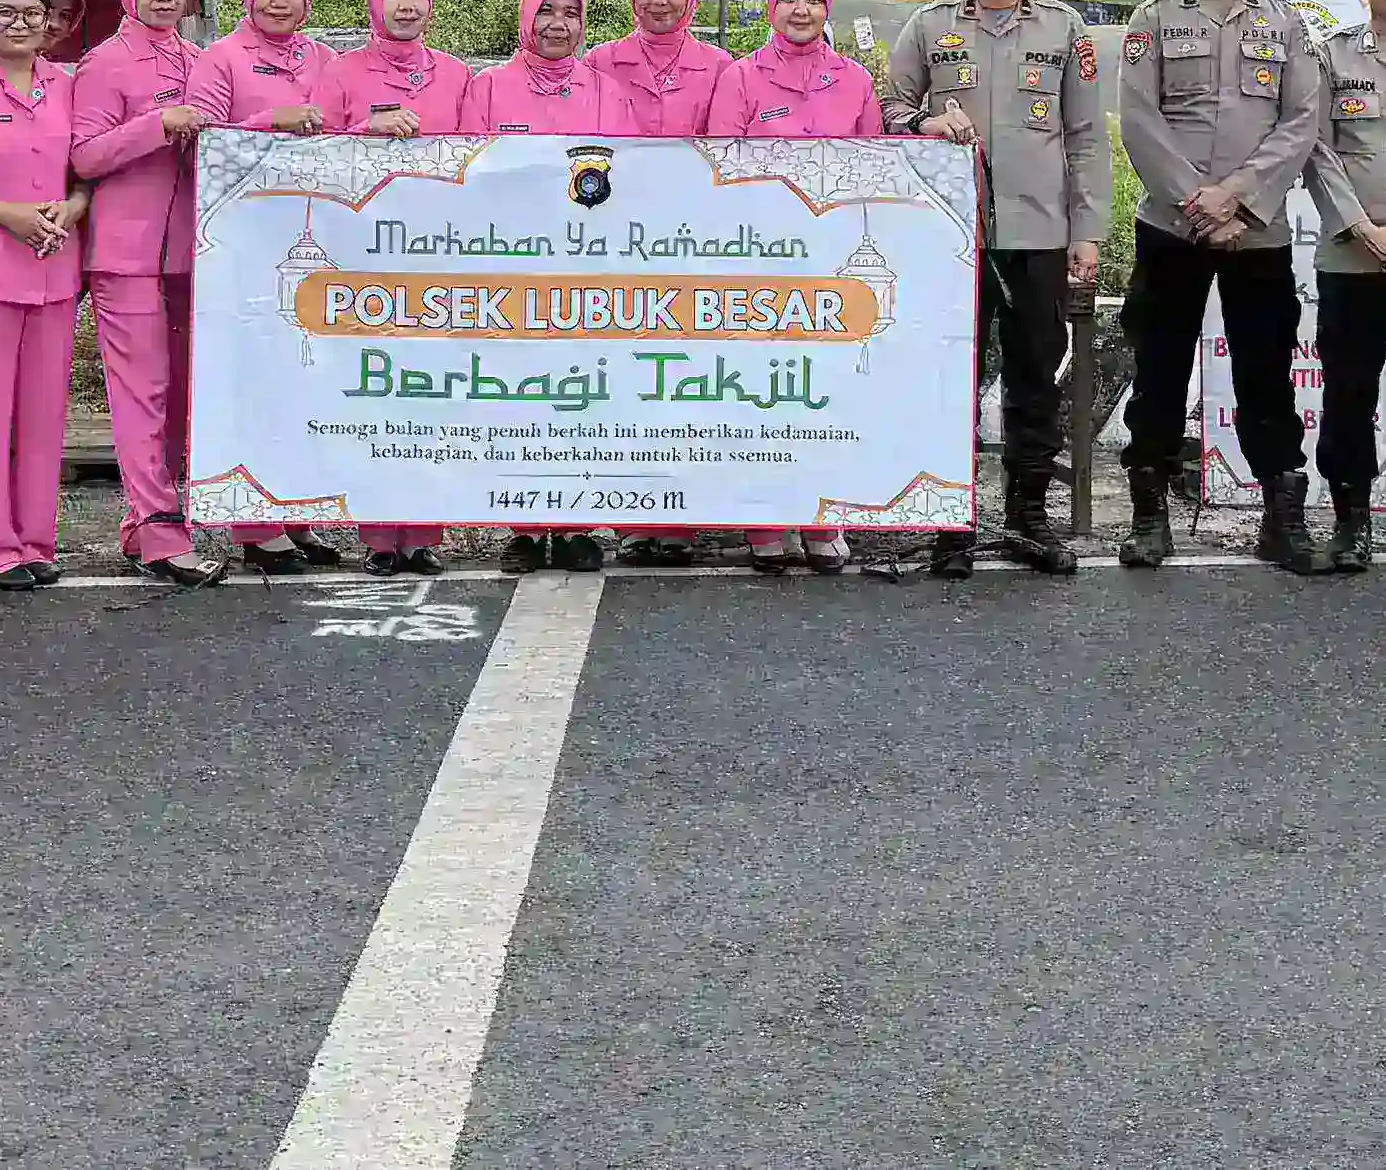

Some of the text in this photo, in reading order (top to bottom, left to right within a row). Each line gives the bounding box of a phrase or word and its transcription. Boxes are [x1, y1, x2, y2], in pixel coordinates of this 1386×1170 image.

[1242, 29, 1285, 40] POLRI
[931, 51, 970, 65] DASA
[1025, 50, 1062, 66] POLRI
[366, 221, 809, 262] Marhaban Ya Ramadhan
[324, 283, 847, 333] POLSEK LUBUK BESAR
[341, 347, 830, 412] Berbagi Takjil
[307, 419, 860, 442] Semoga bulan yang penuh berkah ini memberikan kedamaian,
[371, 443, 798, 463] kebahagian, dan keberkahan untuk kita ssemua.
[488, 491, 686, 510] 1447 H / 2026 M
